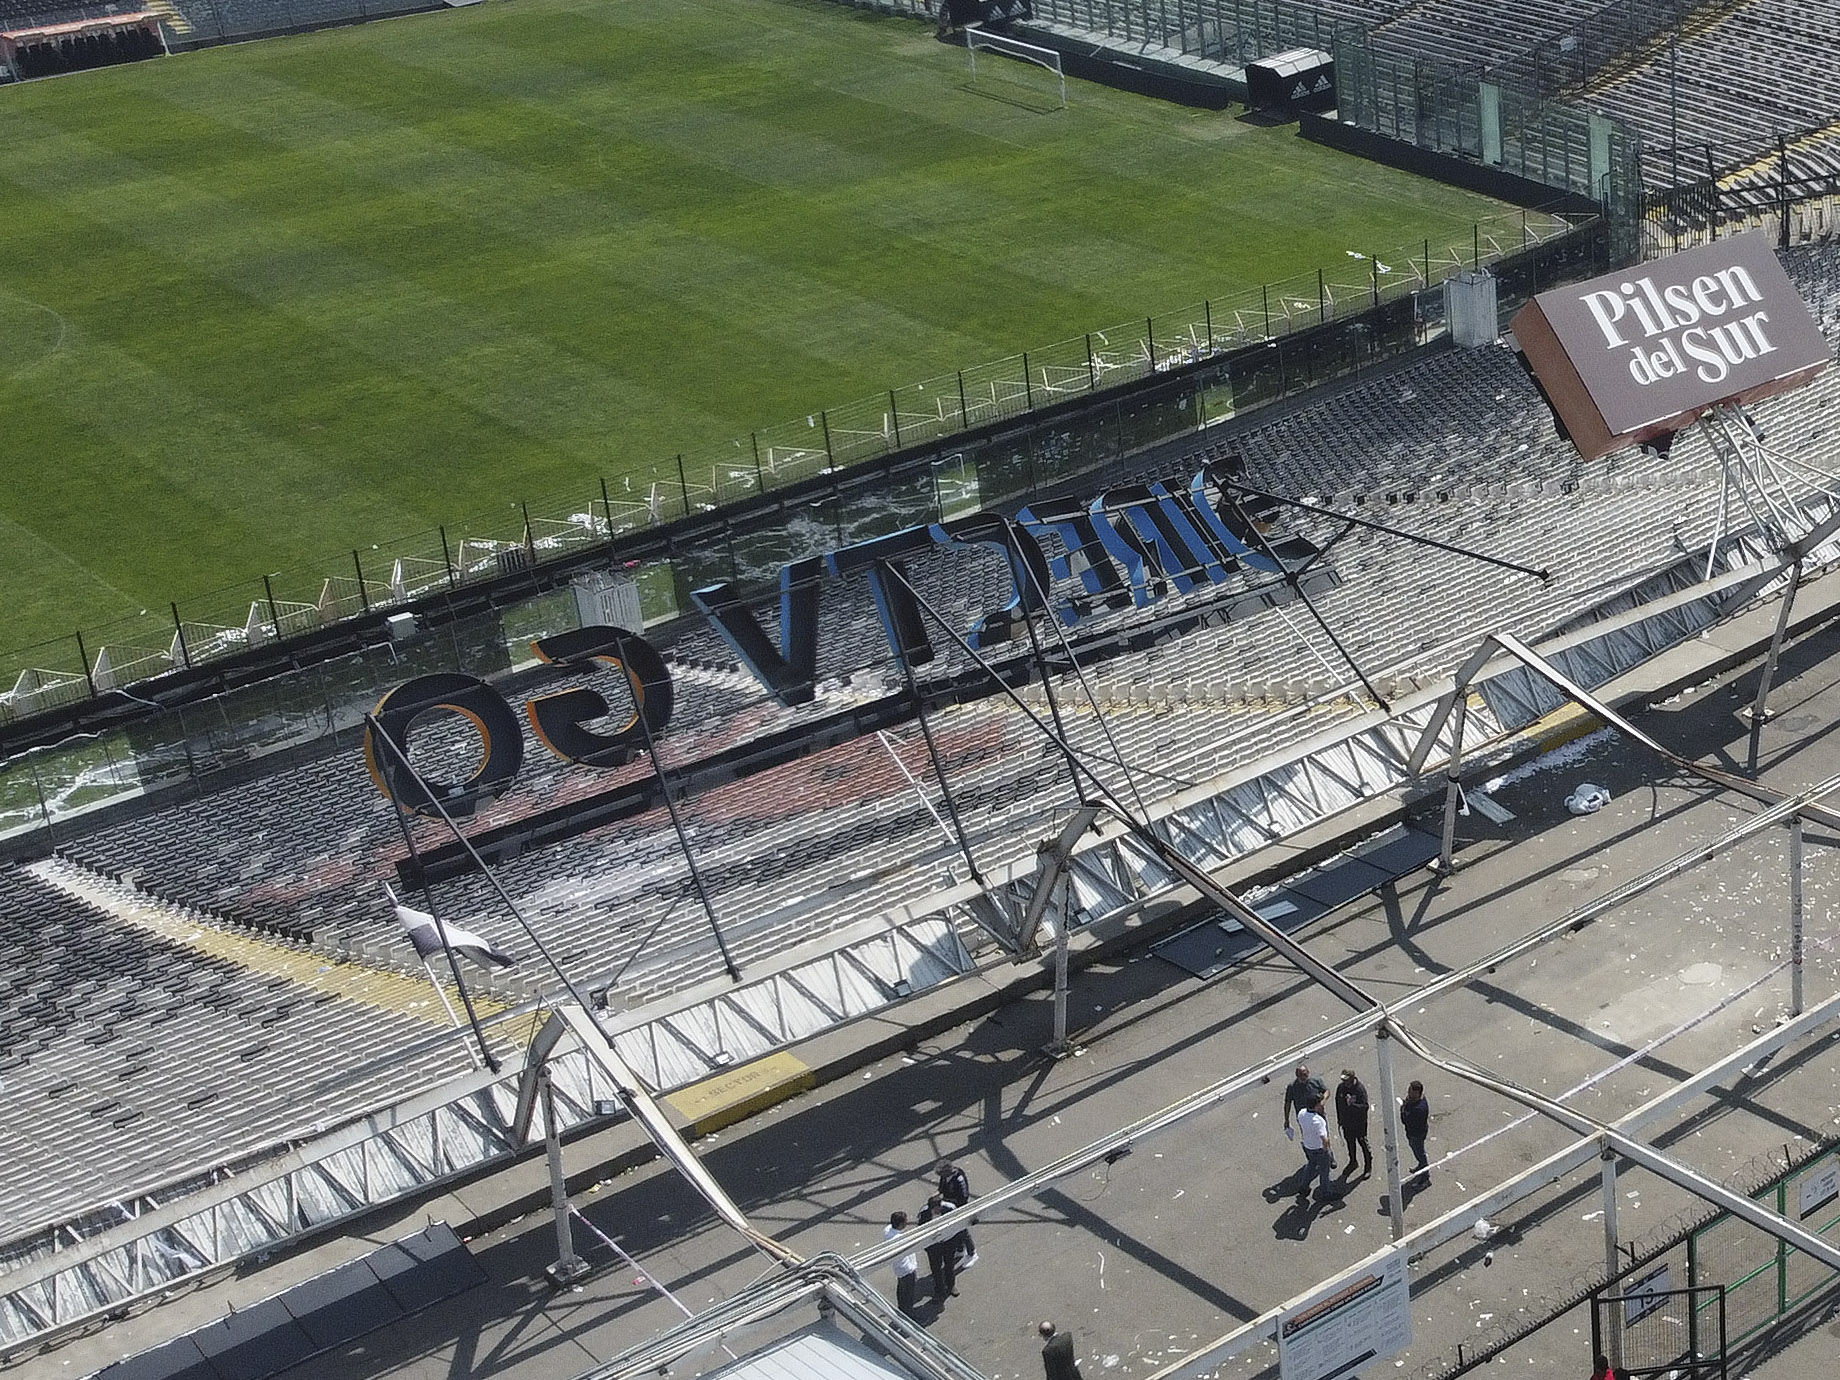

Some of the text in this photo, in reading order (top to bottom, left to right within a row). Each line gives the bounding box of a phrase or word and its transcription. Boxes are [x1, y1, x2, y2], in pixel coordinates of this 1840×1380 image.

[1579, 265, 1764, 350] Pilsen
[1629, 309, 1778, 386] del Sur
[708, 1071, 762, 1096] SECTOR
